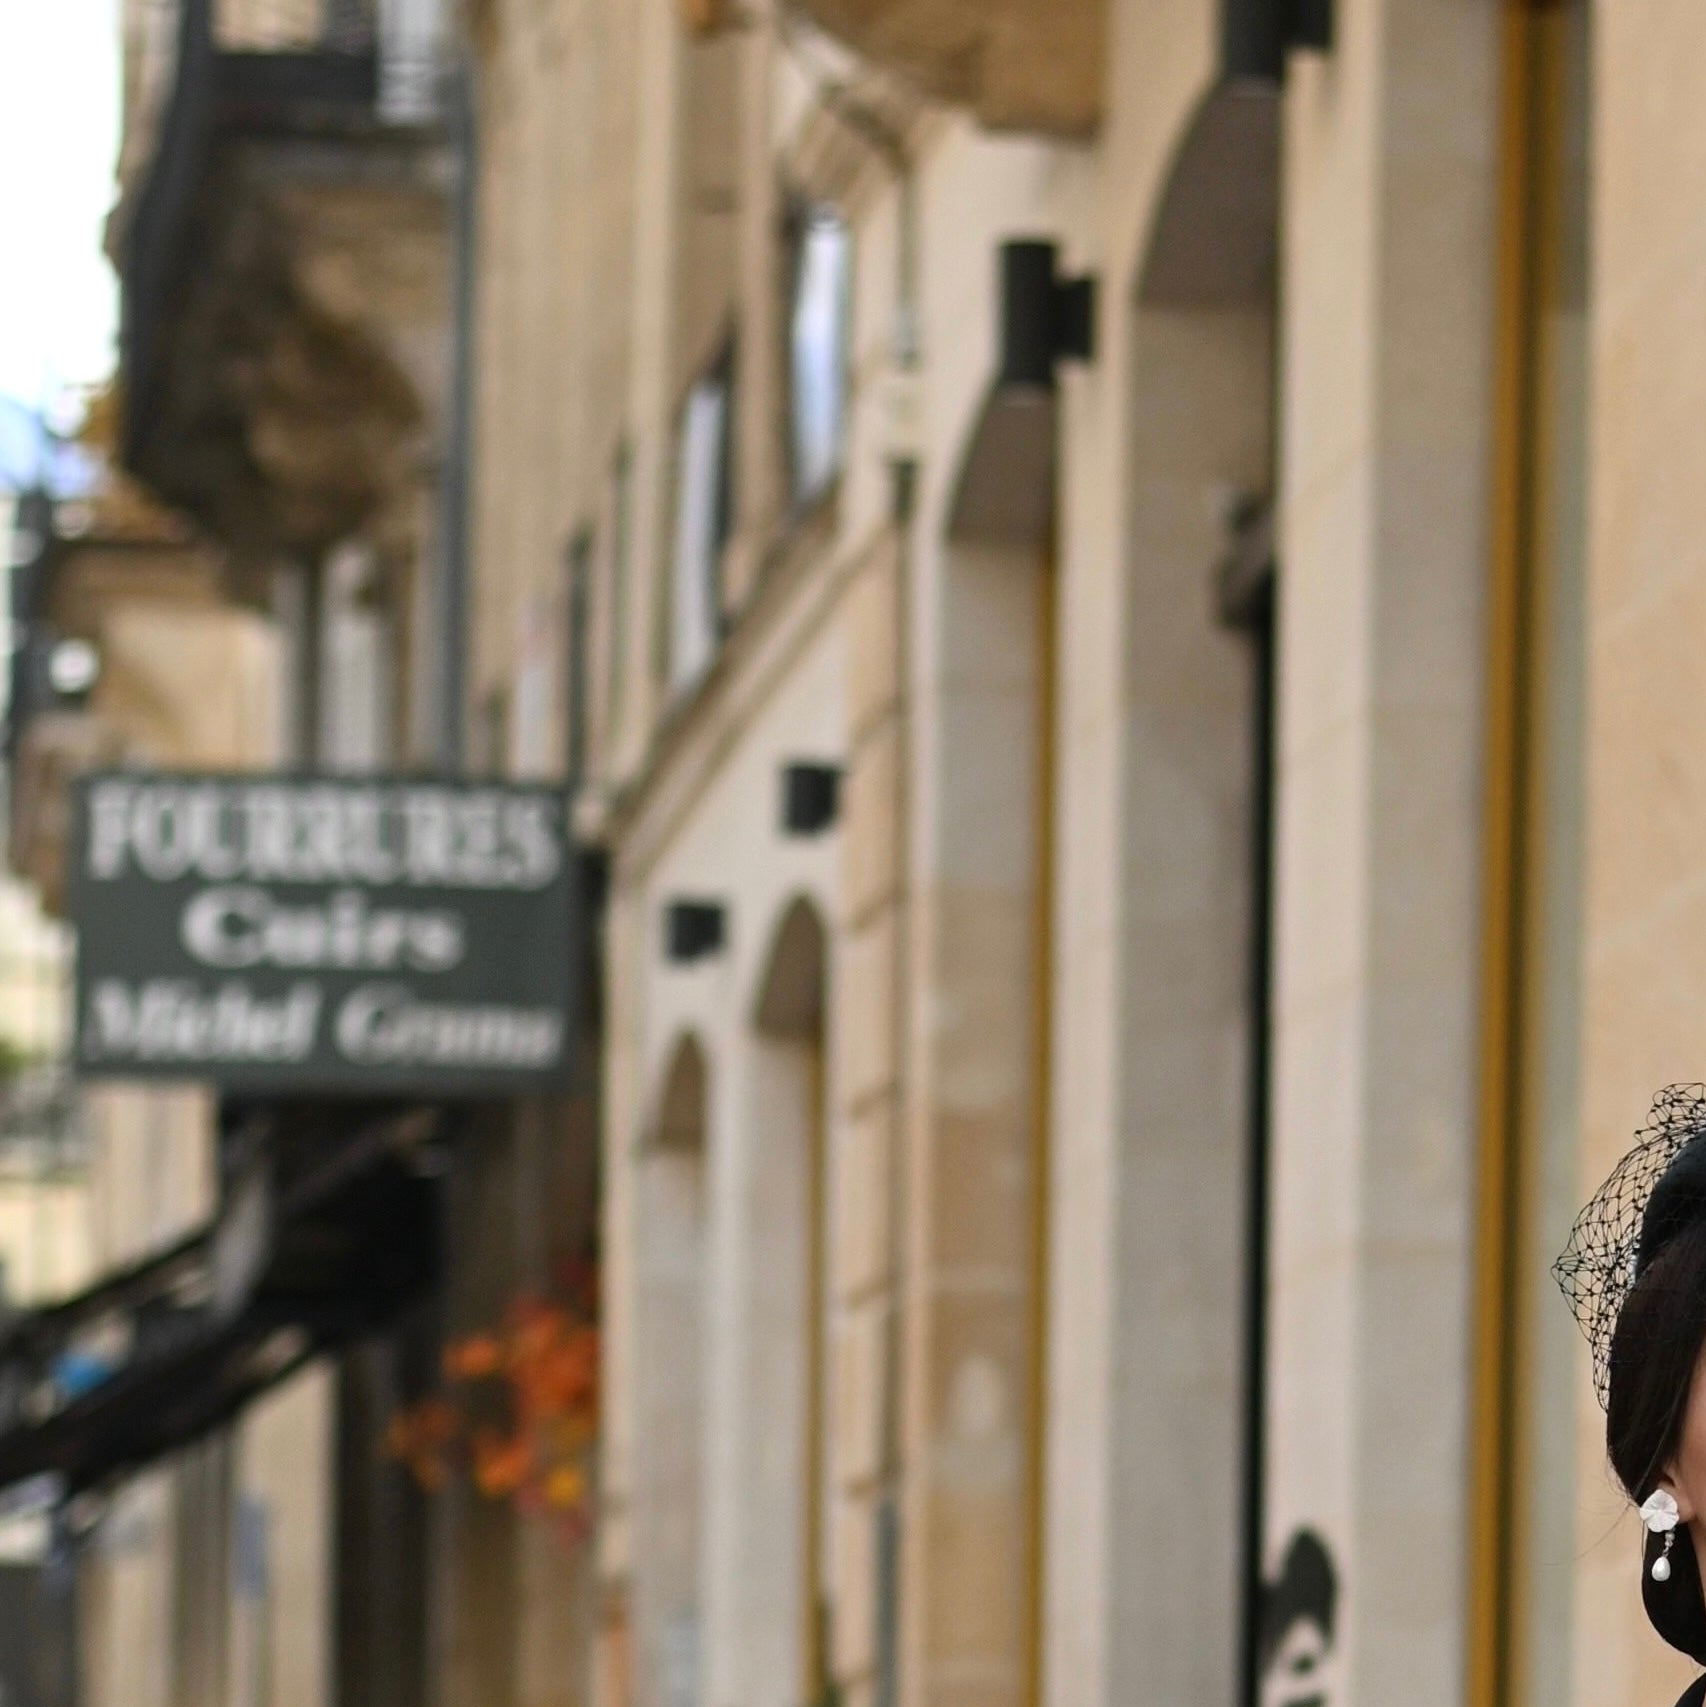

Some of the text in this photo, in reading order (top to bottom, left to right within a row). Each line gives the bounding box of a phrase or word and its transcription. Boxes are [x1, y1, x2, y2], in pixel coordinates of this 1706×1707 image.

[90, 780, 562, 891] FOURRURES
[180, 884, 467, 972] Cuirs
[82, 978, 322, 1065] Michel
